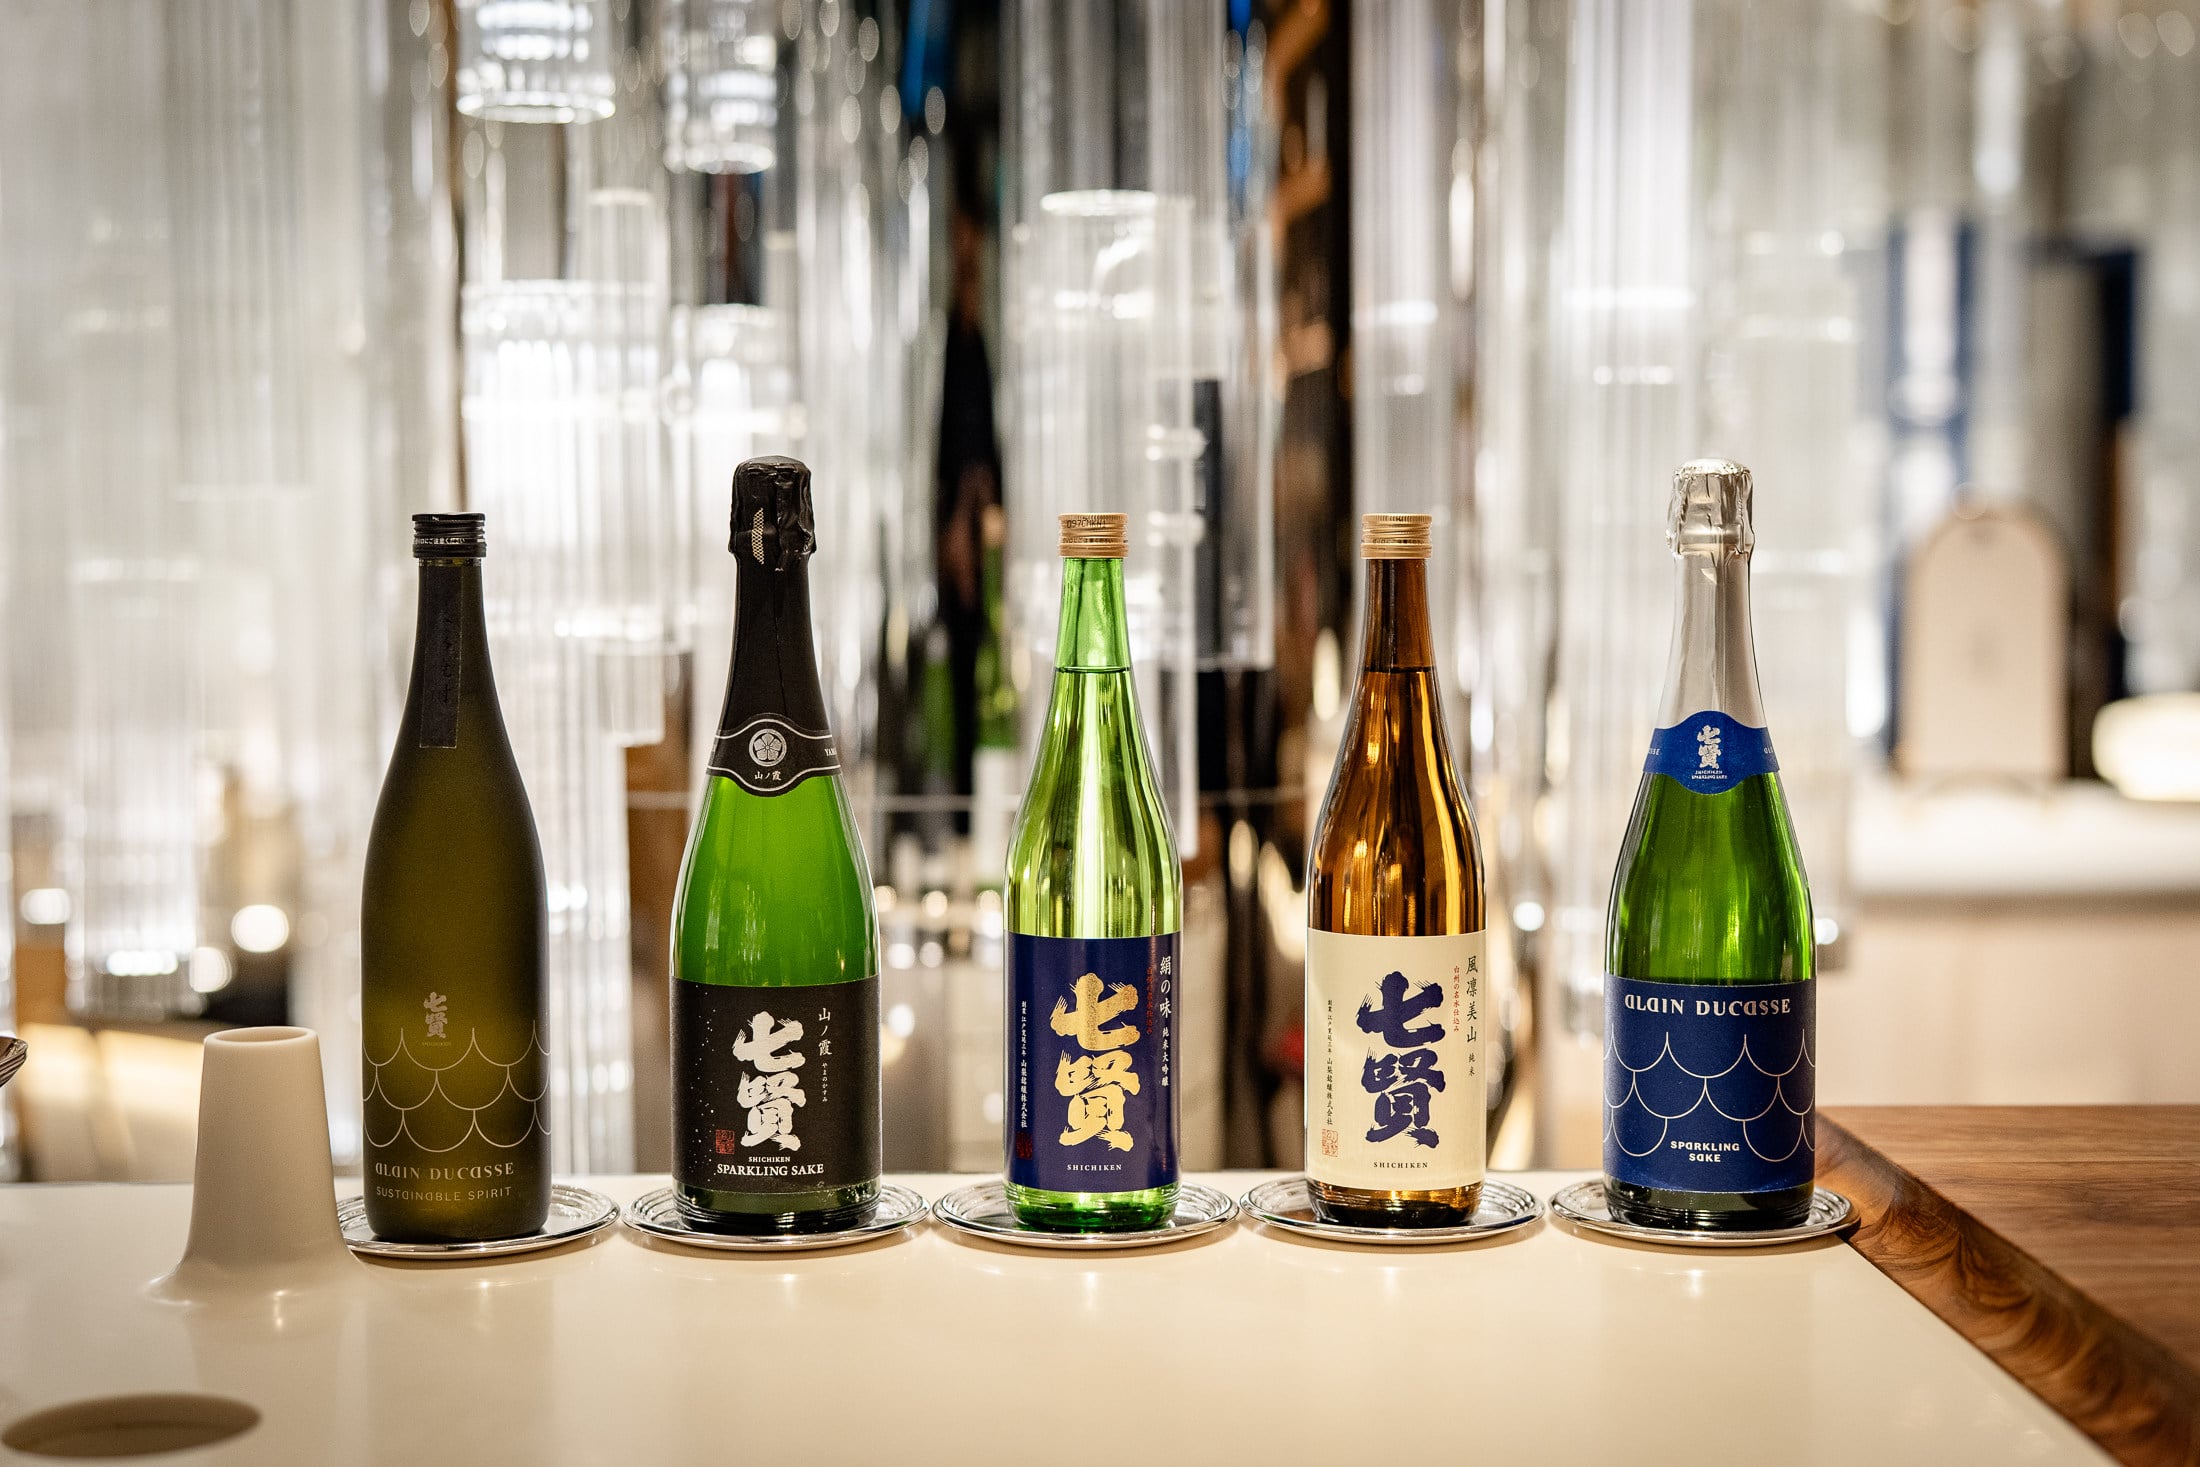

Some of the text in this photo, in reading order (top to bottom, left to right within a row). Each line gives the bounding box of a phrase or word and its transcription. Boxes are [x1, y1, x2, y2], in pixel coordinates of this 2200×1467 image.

[1697, 724, 1721, 770] 七賢
[754, 770, 782, 781] 山ノ霞
[1159, 955, 1172, 1019] 絹の味
[423, 991, 448, 1039] 七賢
[818, 1007, 833, 1056] 山ノ霞
[732, 1010, 806, 1151] 七賢
[1050, 972, 1141, 1152] 七賢
[1356, 970, 1447, 1149] 七賢
[1468, 1053, 1475, 1077] 純米
[717, 1163, 825, 1176] SPARKLING SAKE
[1067, 1163, 1122, 1171] SHICHIKEN
[1373, 1161, 1428, 1169] SHICHIKEN
[468, 1186, 512, 1201] SPIRIT
